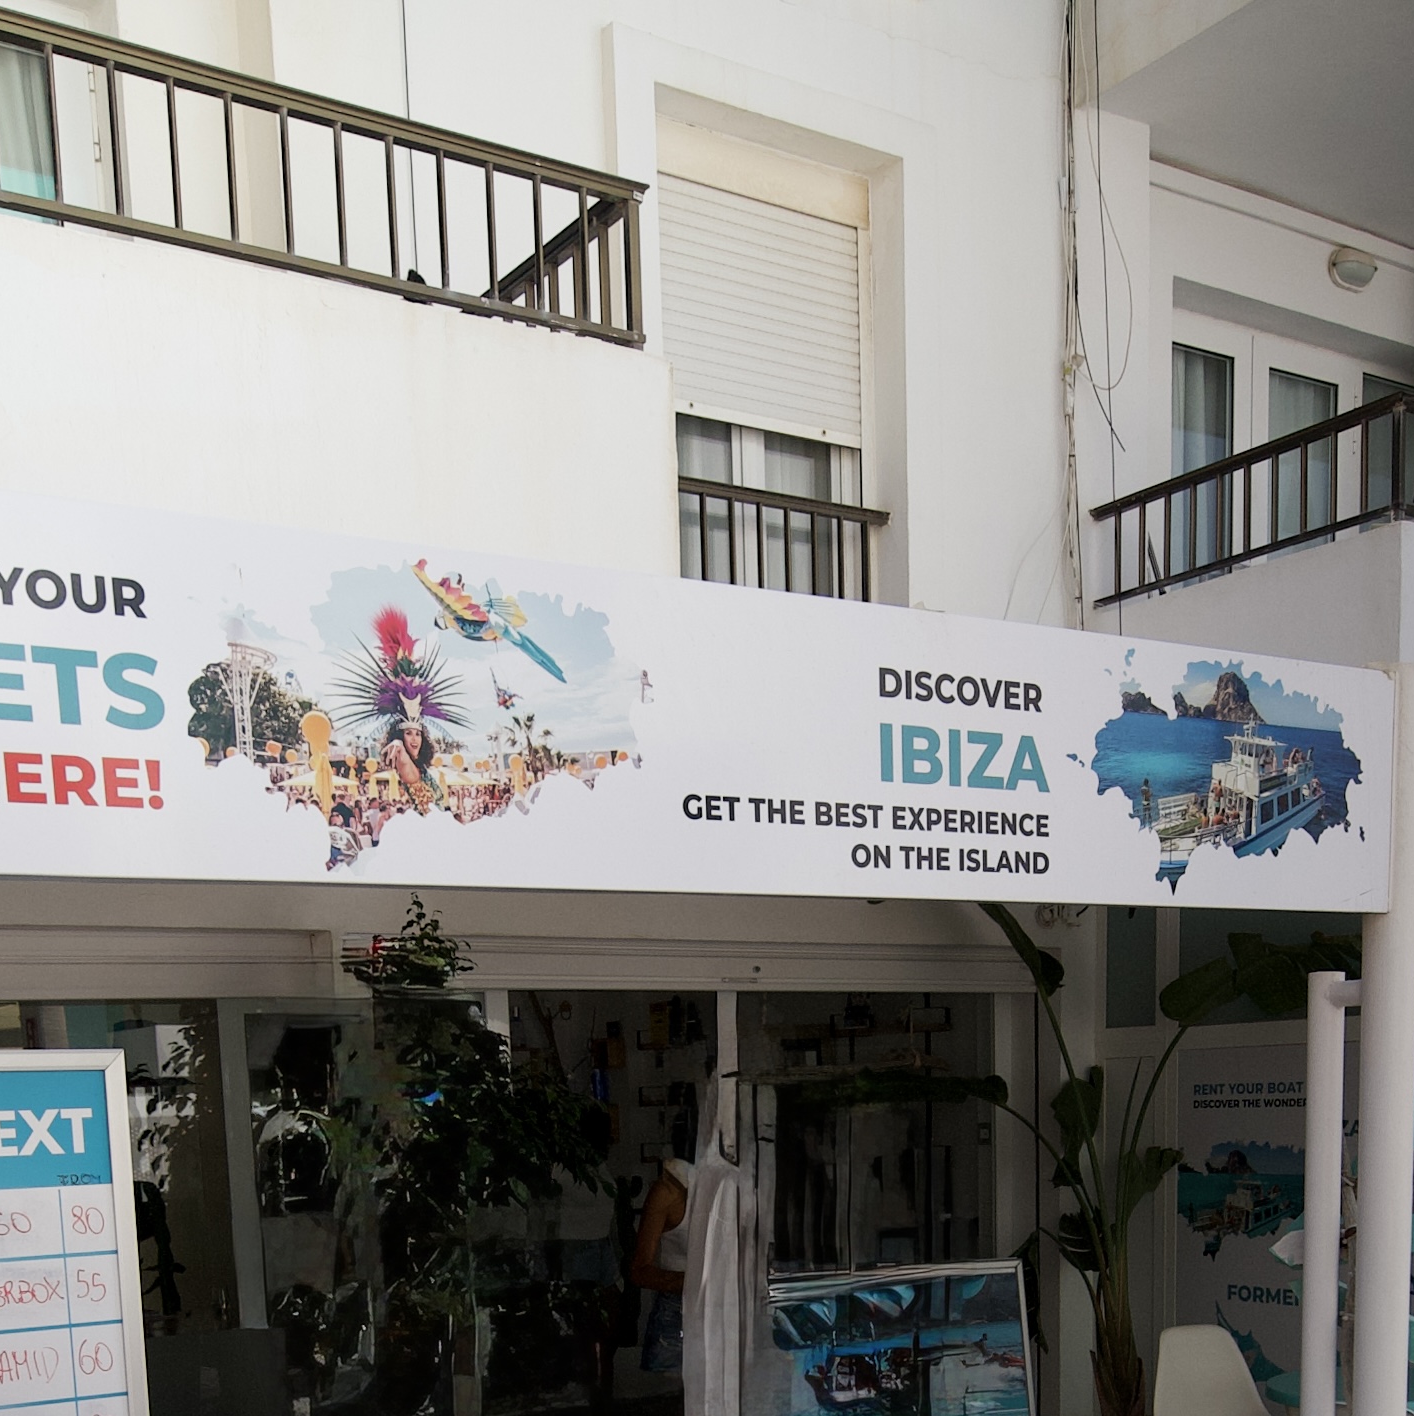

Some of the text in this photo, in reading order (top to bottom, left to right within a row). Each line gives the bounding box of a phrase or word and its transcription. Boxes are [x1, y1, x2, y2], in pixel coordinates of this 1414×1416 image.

[877, 667, 1042, 713] DISCOVER
[879, 723, 1051, 794] IBIZA
[682, 793, 1050, 838] GET THE BEST EXPERIENCE
[850, 843, 1050, 875] ON THE ISLAND
[1193, 1081, 1304, 1096] RENT YOUR BOAT
[1193, 1098, 1261, 1109] DISCOVER THE
[71, 1205, 105, 1235] 80
[77, 1269, 107, 1302] 55
[79, 1339, 113, 1375] 60
